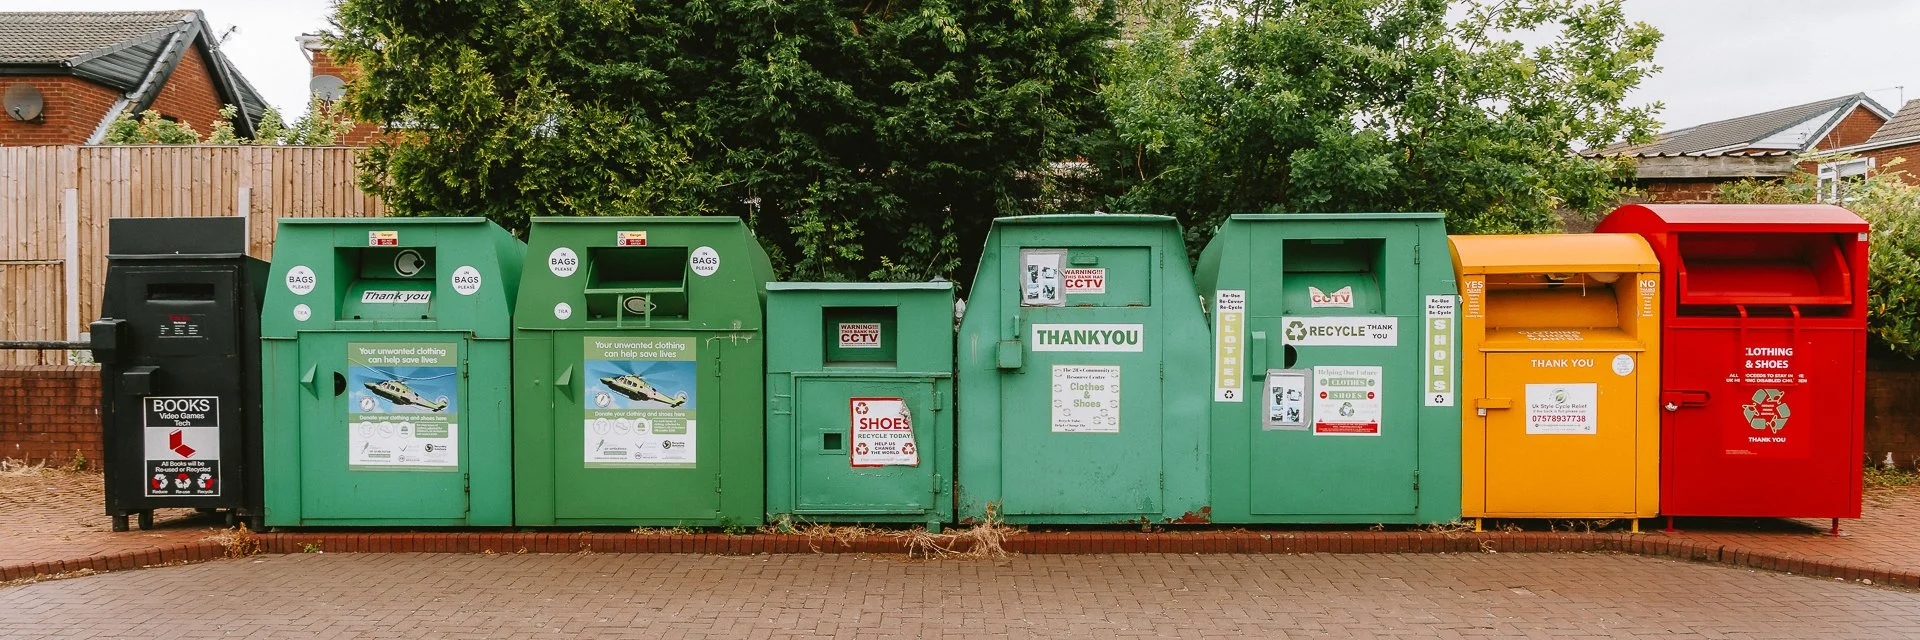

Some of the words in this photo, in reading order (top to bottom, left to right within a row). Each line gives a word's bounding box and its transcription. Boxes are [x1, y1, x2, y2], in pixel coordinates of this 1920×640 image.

[1065, 279, 1103, 288] CCTV
[1465, 281, 1483, 289] YES
[364, 291, 403, 300] Thank
[404, 293, 429, 302] you
[1312, 295, 1350, 303] CCTV
[1309, 326, 1366, 336] RECYCLE
[841, 334, 878, 342] CCTV
[1037, 330, 1138, 345] THANKYOU
[614, 341, 653, 349] unwanted
[655, 341, 685, 351] clothing
[1224, 314, 1236, 386] CLOTHES
[416, 347, 446, 356] clothing
[620, 350, 637, 358] help
[1433, 319, 1446, 391] SHOES
[384, 356, 400, 364] help
[1531, 359, 1568, 367] THANK
[1571, 359, 1594, 367] YOU
[1745, 360, 1754, 368] &
[1755, 360, 1789, 368] SHOES
[1070, 382, 1104, 391] Clothes
[1083, 391, 1090, 399] &
[153, 399, 210, 412] BOOKS
[1073, 399, 1101, 407] Shoes
[859, 417, 910, 429] SHOES
